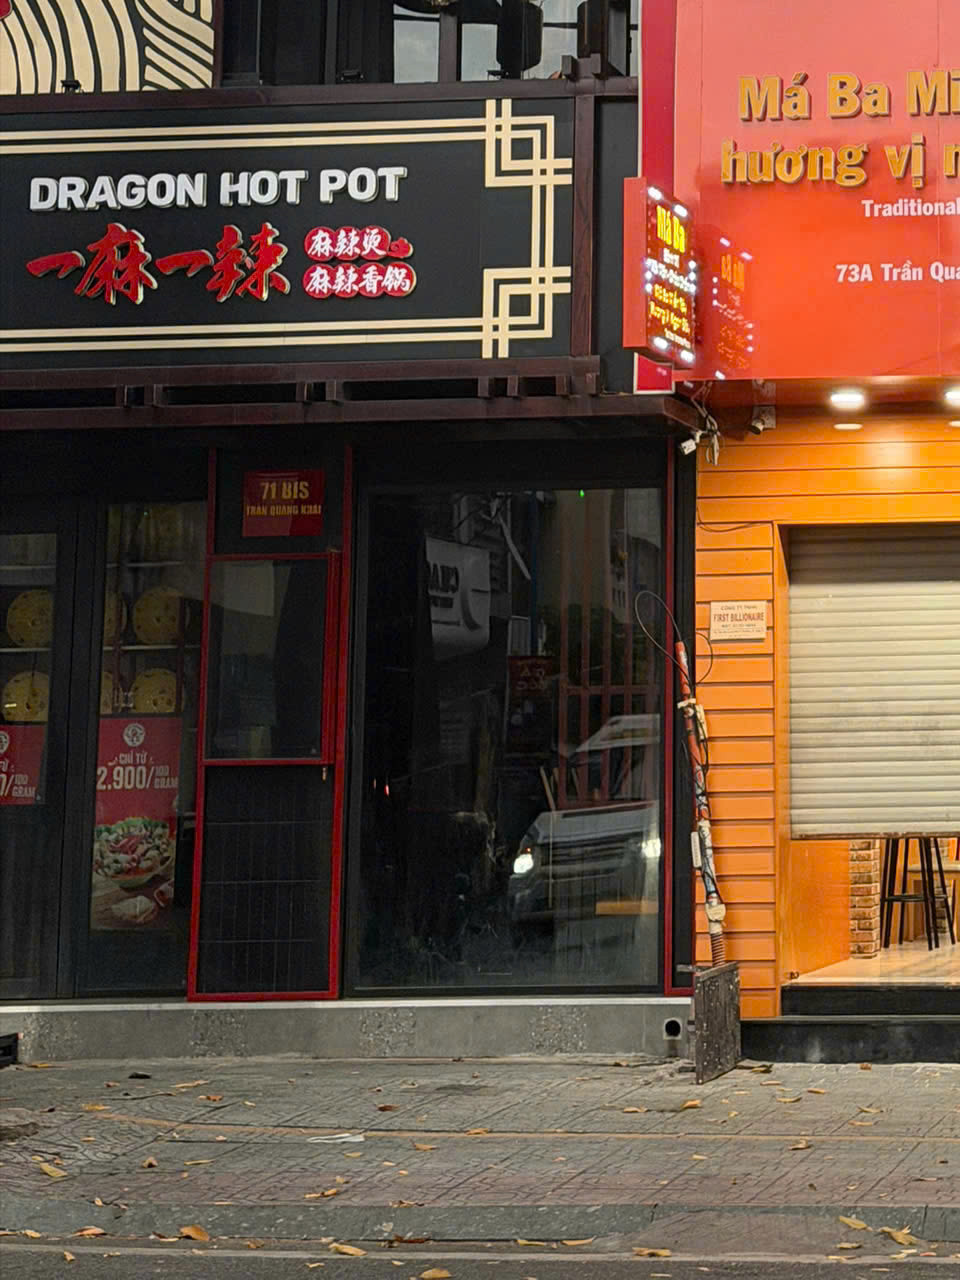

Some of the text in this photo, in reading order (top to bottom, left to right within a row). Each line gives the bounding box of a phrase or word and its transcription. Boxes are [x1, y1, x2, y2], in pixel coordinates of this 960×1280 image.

[739, 70, 810, 121] Má
[827, 72, 890, 118] Ba
[721, 138, 868, 187] hương
[885, 132, 925, 188] vị
[30, 167, 407, 211] DRAGON HOT POT
[861, 197, 960, 217] Traditional
[26, 222, 291, 304] 一麻一辣
[304, 265, 411, 294] 麻辣香锅
[836, 264, 873, 282] 73A
[880, 260, 923, 282] Trần
[261, 482, 276, 499] 71
